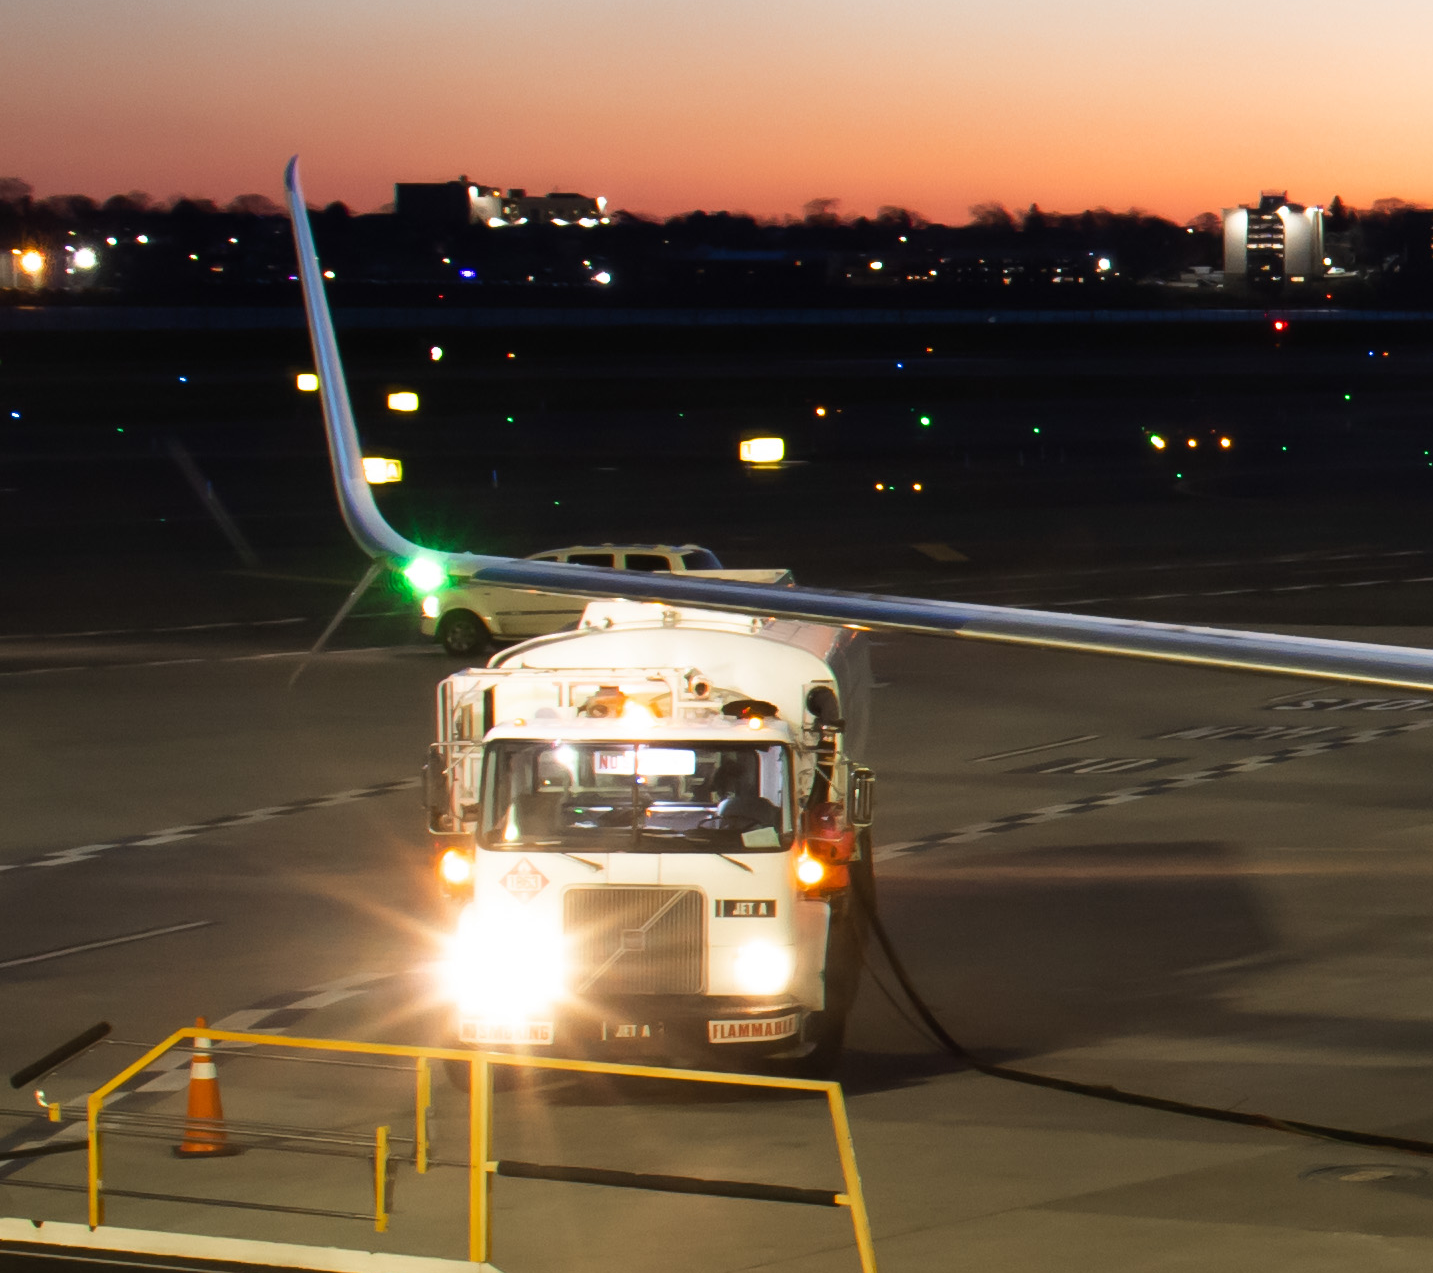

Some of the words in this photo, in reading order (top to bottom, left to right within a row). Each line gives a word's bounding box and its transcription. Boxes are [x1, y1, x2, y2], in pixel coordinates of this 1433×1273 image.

[732, 902, 755, 916] JET
[758, 902, 767, 915] A
[615, 1024, 637, 1038] JET
[641, 1024, 651, 1038] A
[713, 1017, 793, 1039] FLAMMABLE
